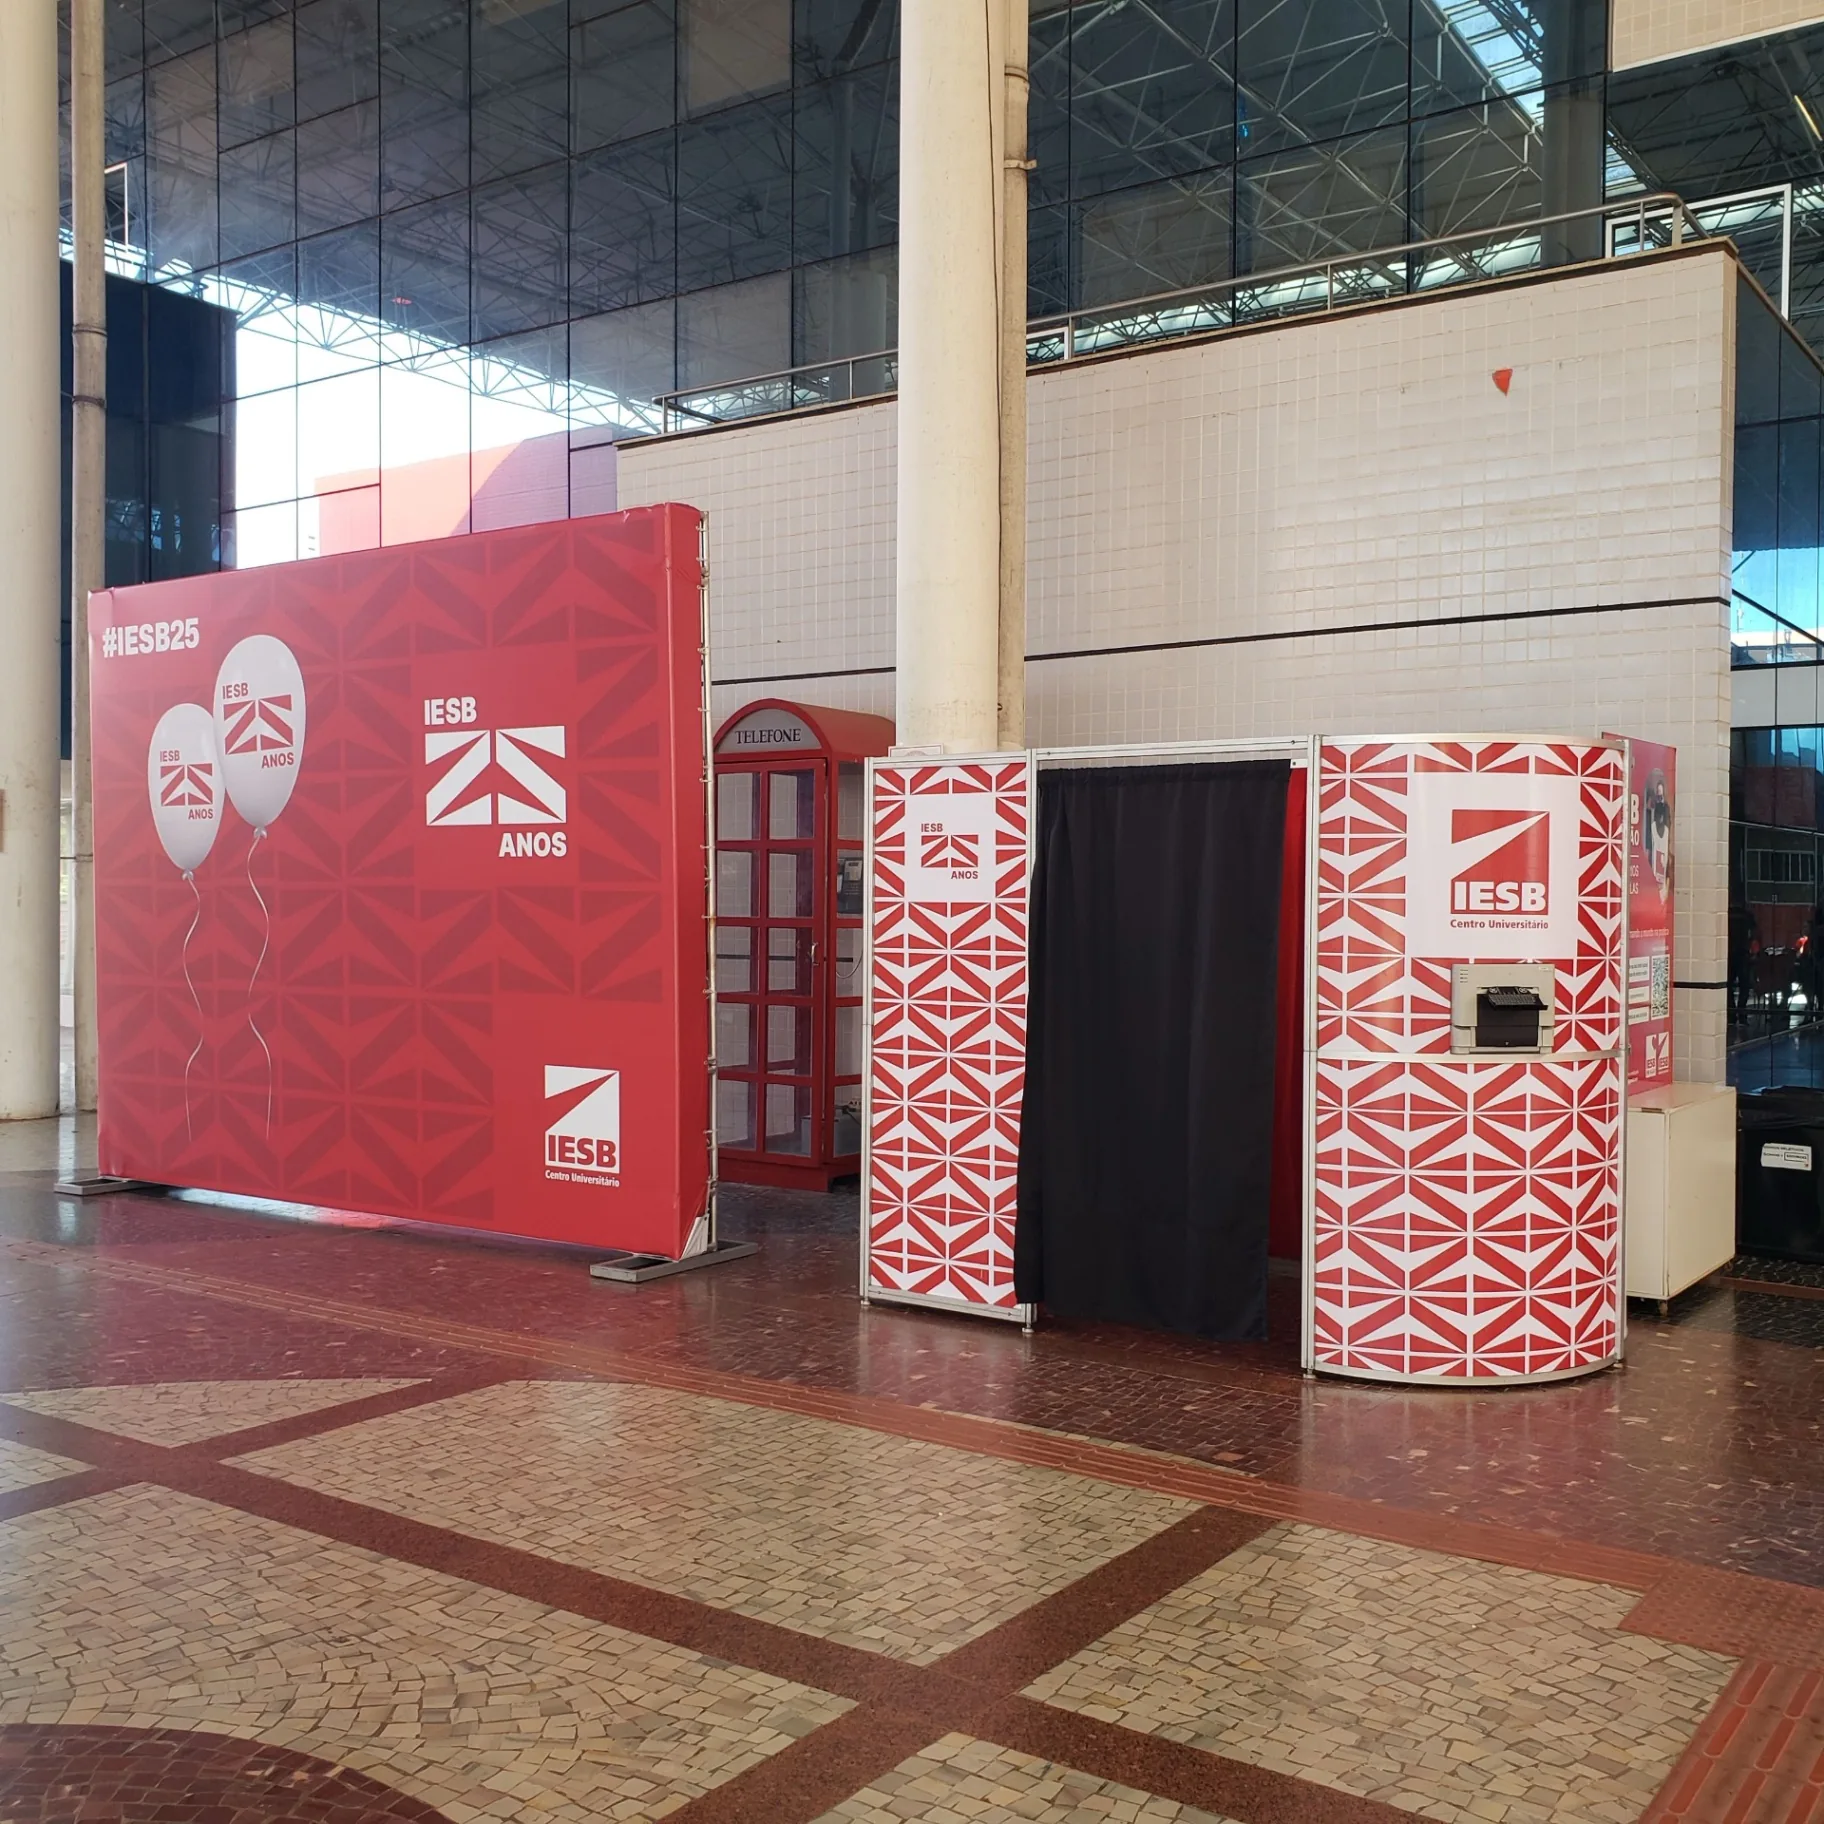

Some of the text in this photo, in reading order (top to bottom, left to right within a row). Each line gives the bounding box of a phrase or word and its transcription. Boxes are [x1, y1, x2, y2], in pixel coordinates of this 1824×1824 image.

[102, 617, 200, 658] #IESB25
[222, 682, 249, 700] IESB
[424, 696, 477, 726] IESB
[735, 728, 802, 744] TELEFONE
[159, 750, 181, 763] IESB
[261, 752, 295, 769] ANOS
[188, 808, 214, 820] ANOS
[921, 823, 944, 833] IESB
[498, 831, 567, 858] ANOS
[950, 870, 979, 880] ANOS
[1453, 881, 1547, 912] IESB
[1450, 919, 1549, 930] Centro Universitário
[547, 1134, 617, 1169] IESB
[545, 1169, 620, 1187] Centro Universitário
